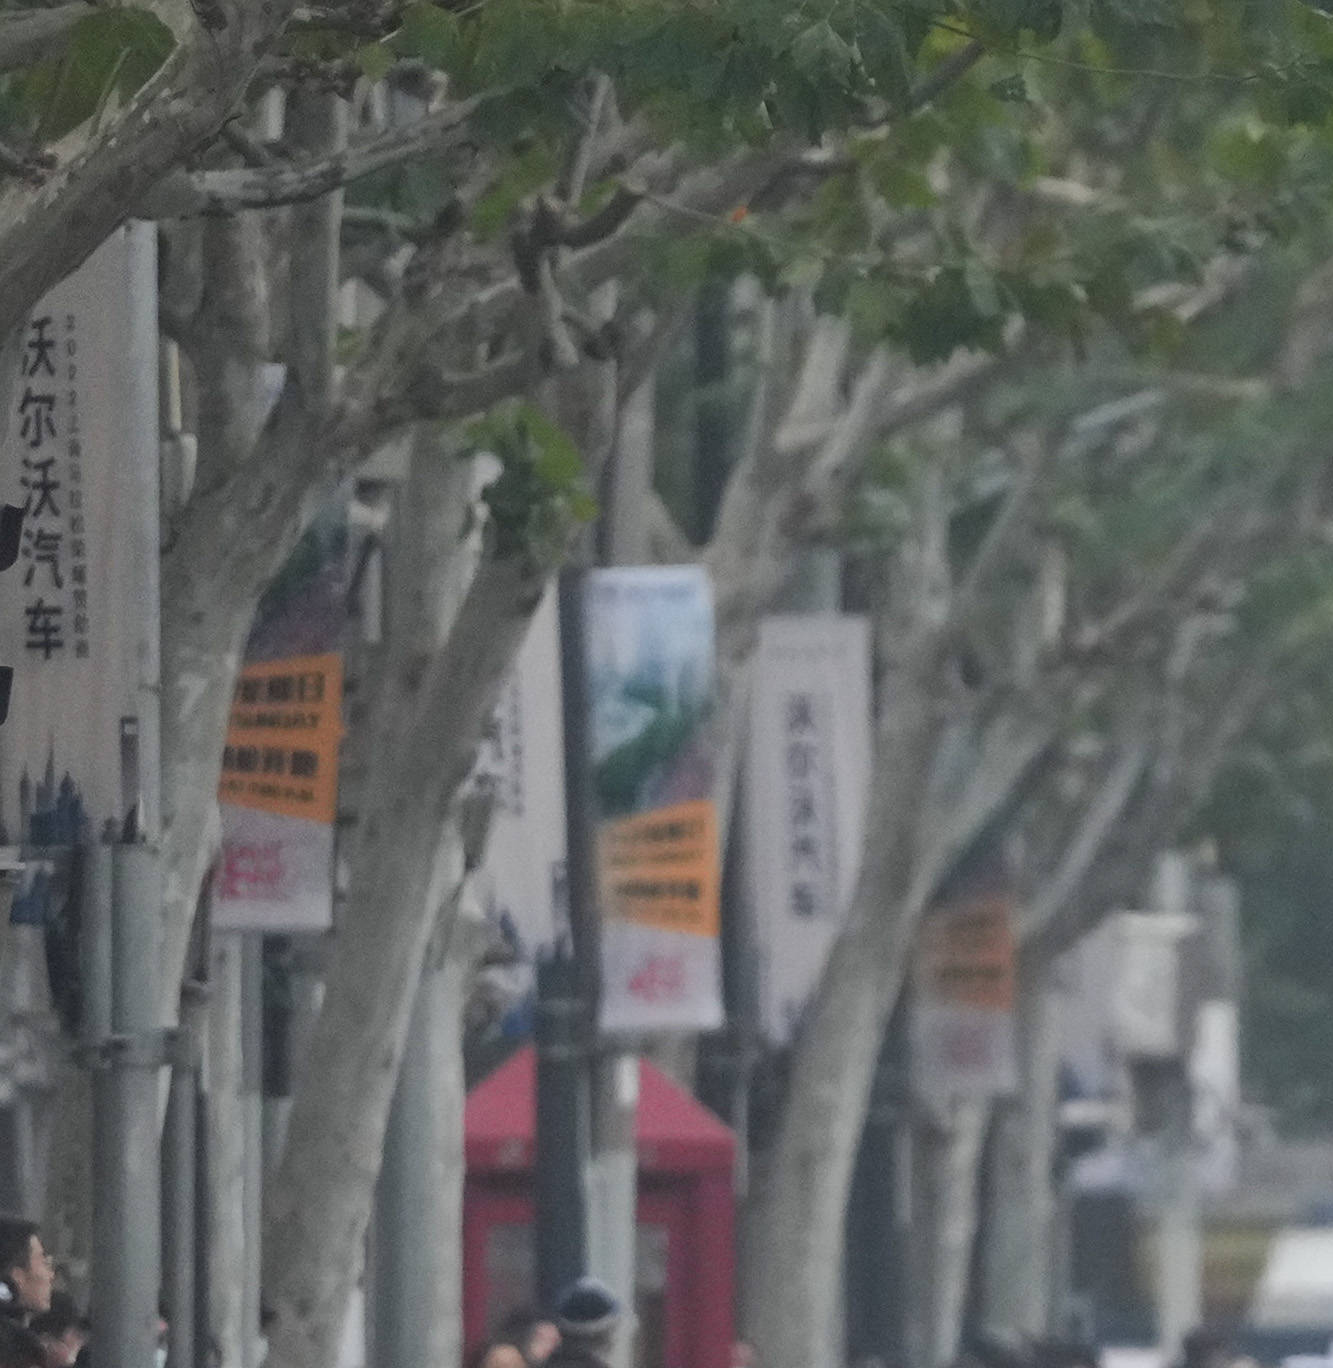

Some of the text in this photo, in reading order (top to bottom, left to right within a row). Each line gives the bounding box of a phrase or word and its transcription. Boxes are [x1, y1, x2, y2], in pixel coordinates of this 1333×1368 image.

[18, 316, 64, 661] 沃尔沃汽车
